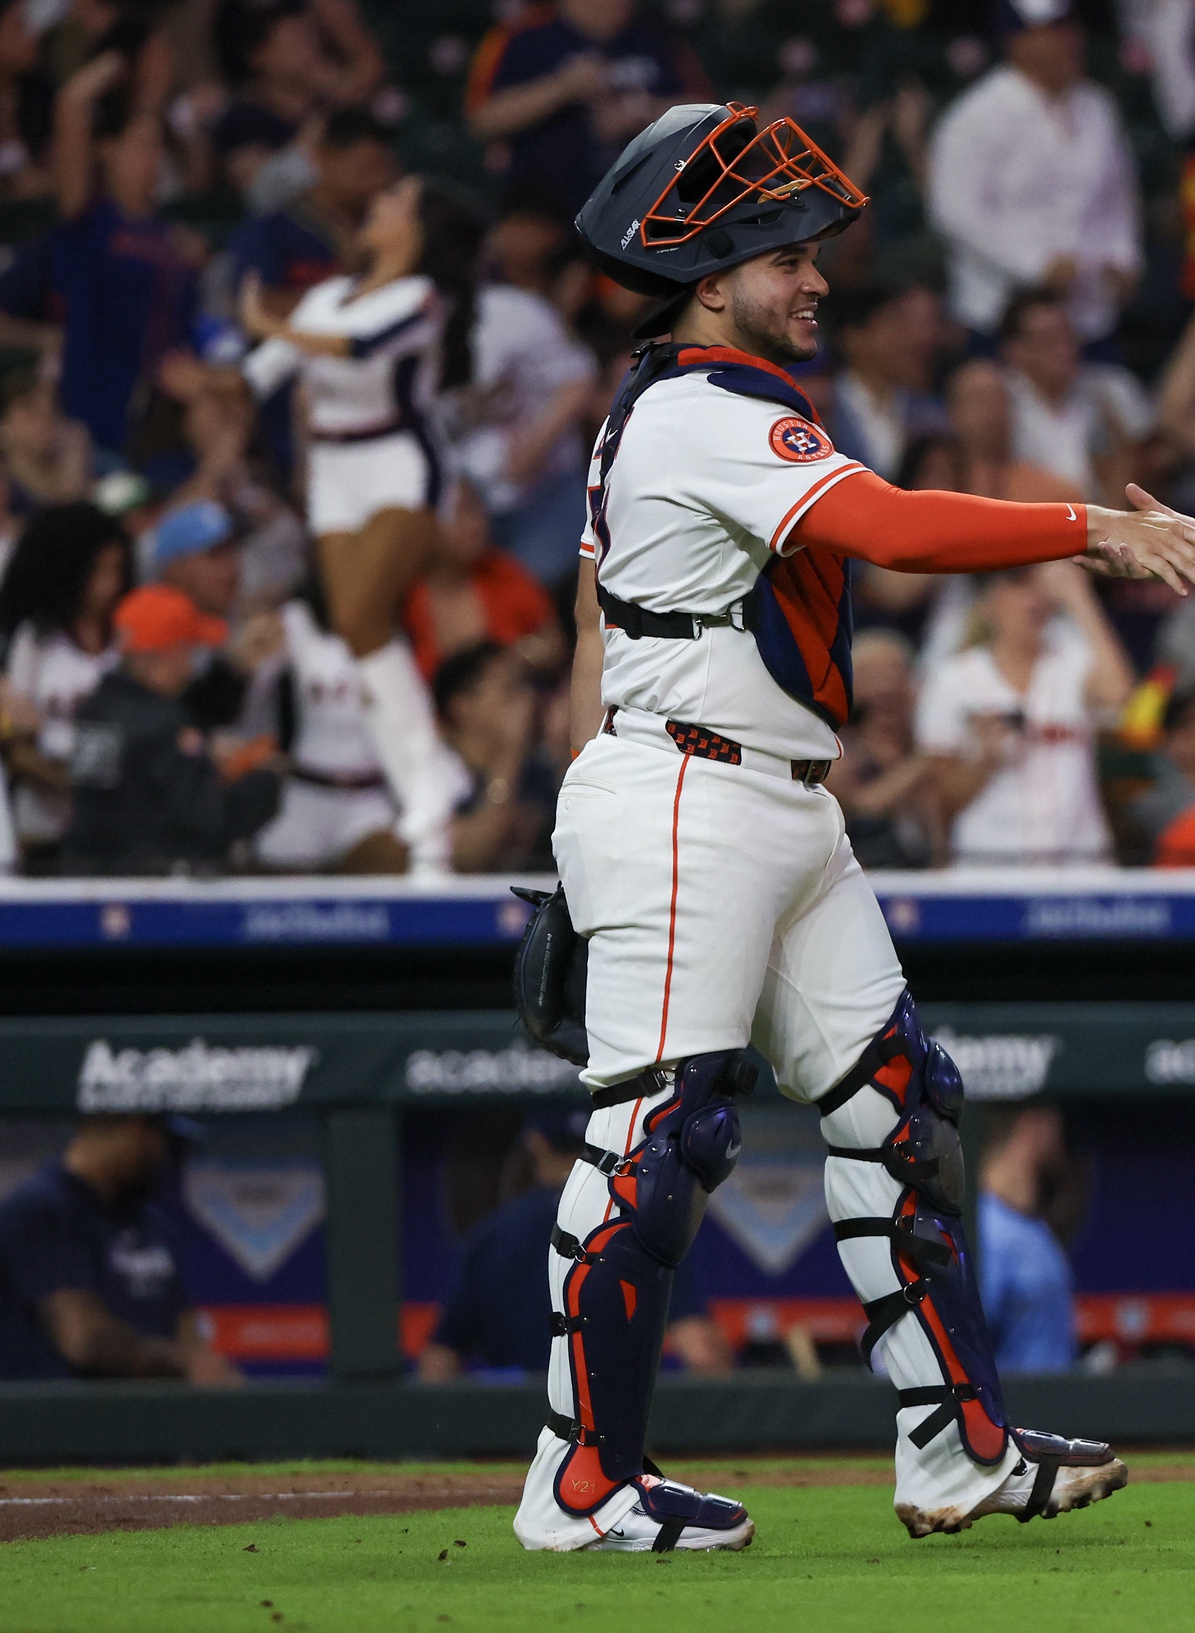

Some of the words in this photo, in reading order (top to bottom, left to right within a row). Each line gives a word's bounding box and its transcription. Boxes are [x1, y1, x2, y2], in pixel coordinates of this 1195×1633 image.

[774, 420, 808, 441] HOUSTON
[797, 445, 829, 460] ASTROS
[571, 1479, 595, 1494] Y21
